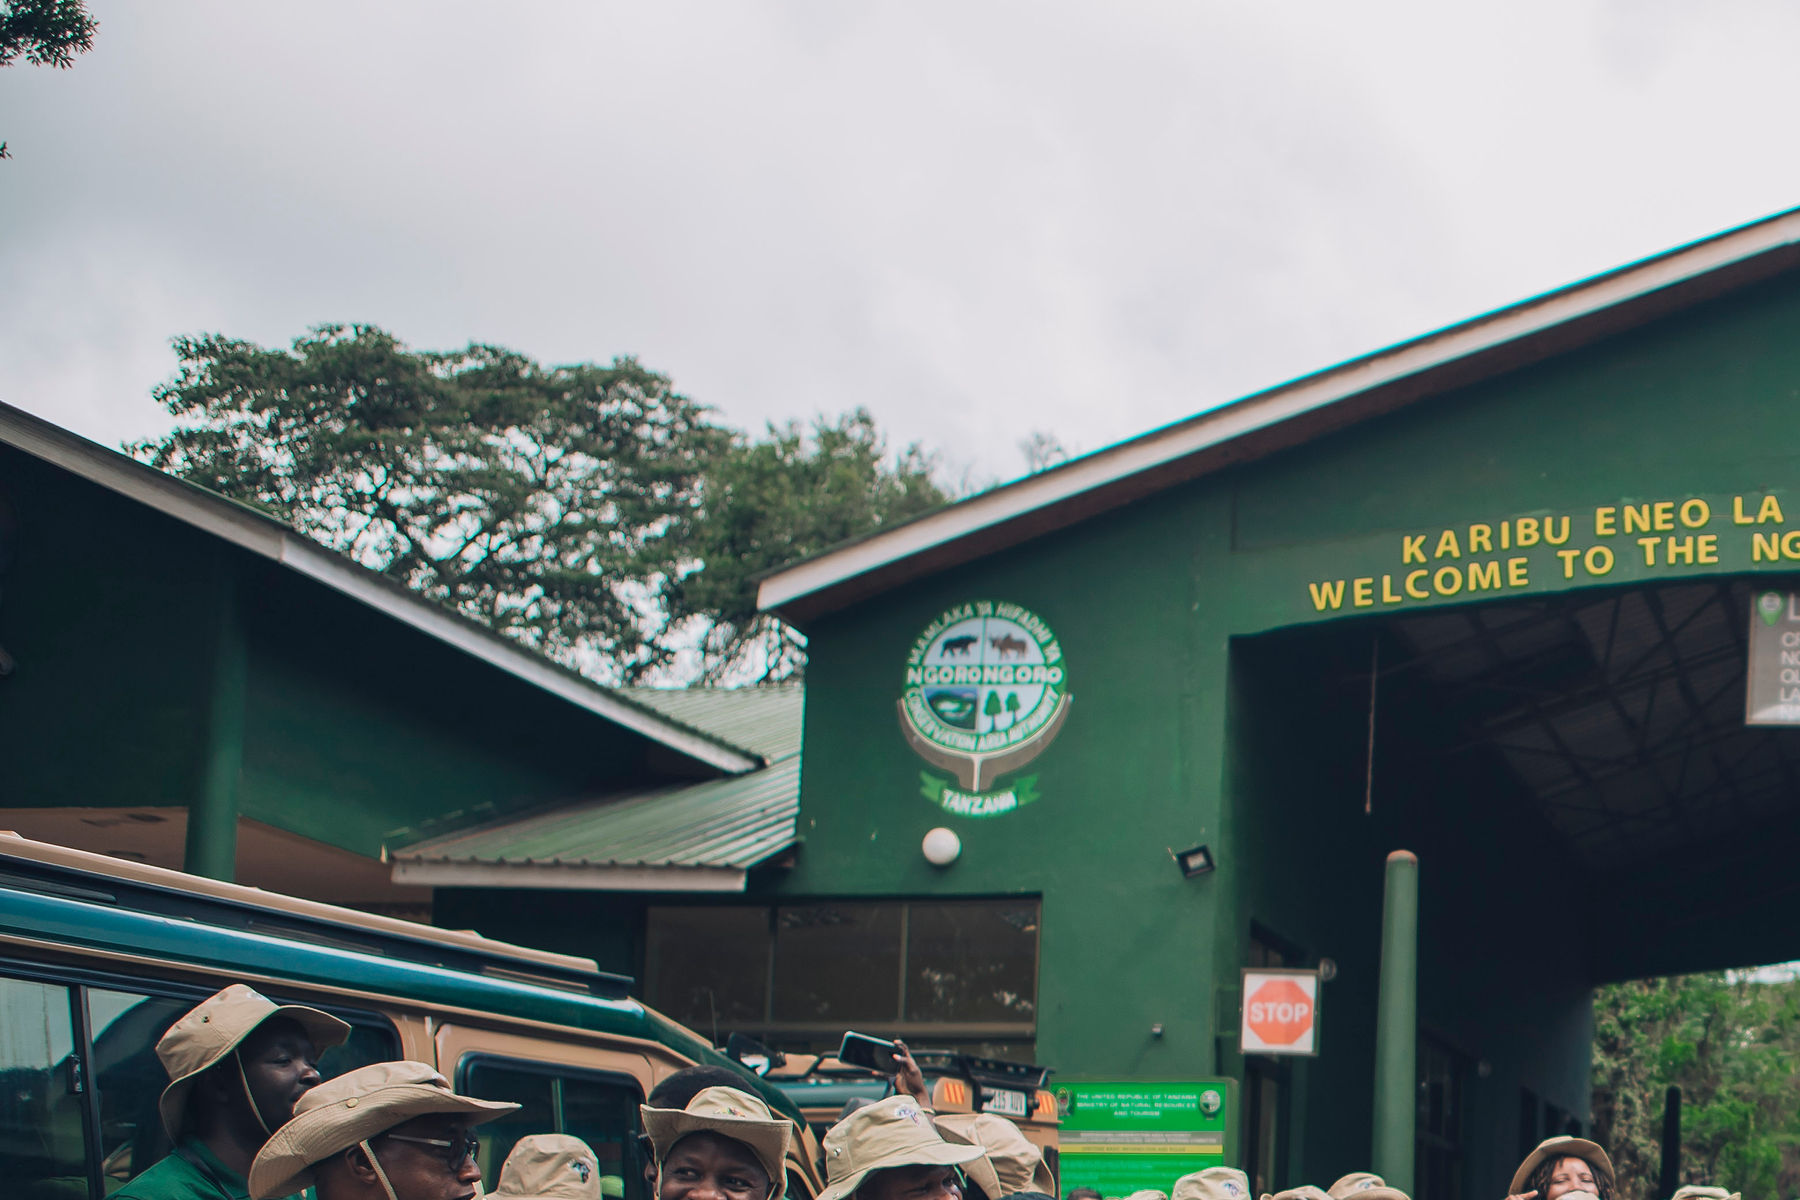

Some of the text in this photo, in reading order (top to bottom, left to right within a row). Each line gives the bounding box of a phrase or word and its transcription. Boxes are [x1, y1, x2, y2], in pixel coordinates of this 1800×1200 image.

[1402, 515, 1572, 564] KARIBU
[1595, 497, 1711, 537] ENEO
[1733, 494, 1785, 525] LA
[1308, 556, 1529, 612] WELCOME
[1557, 545, 1615, 579] TO
[1637, 534, 1719, 567] THE
[907, 666, 1063, 684] NGORONGORO
[942, 788, 1018, 817] TANZANIA
[1250, 1001, 1310, 1024] STOP
